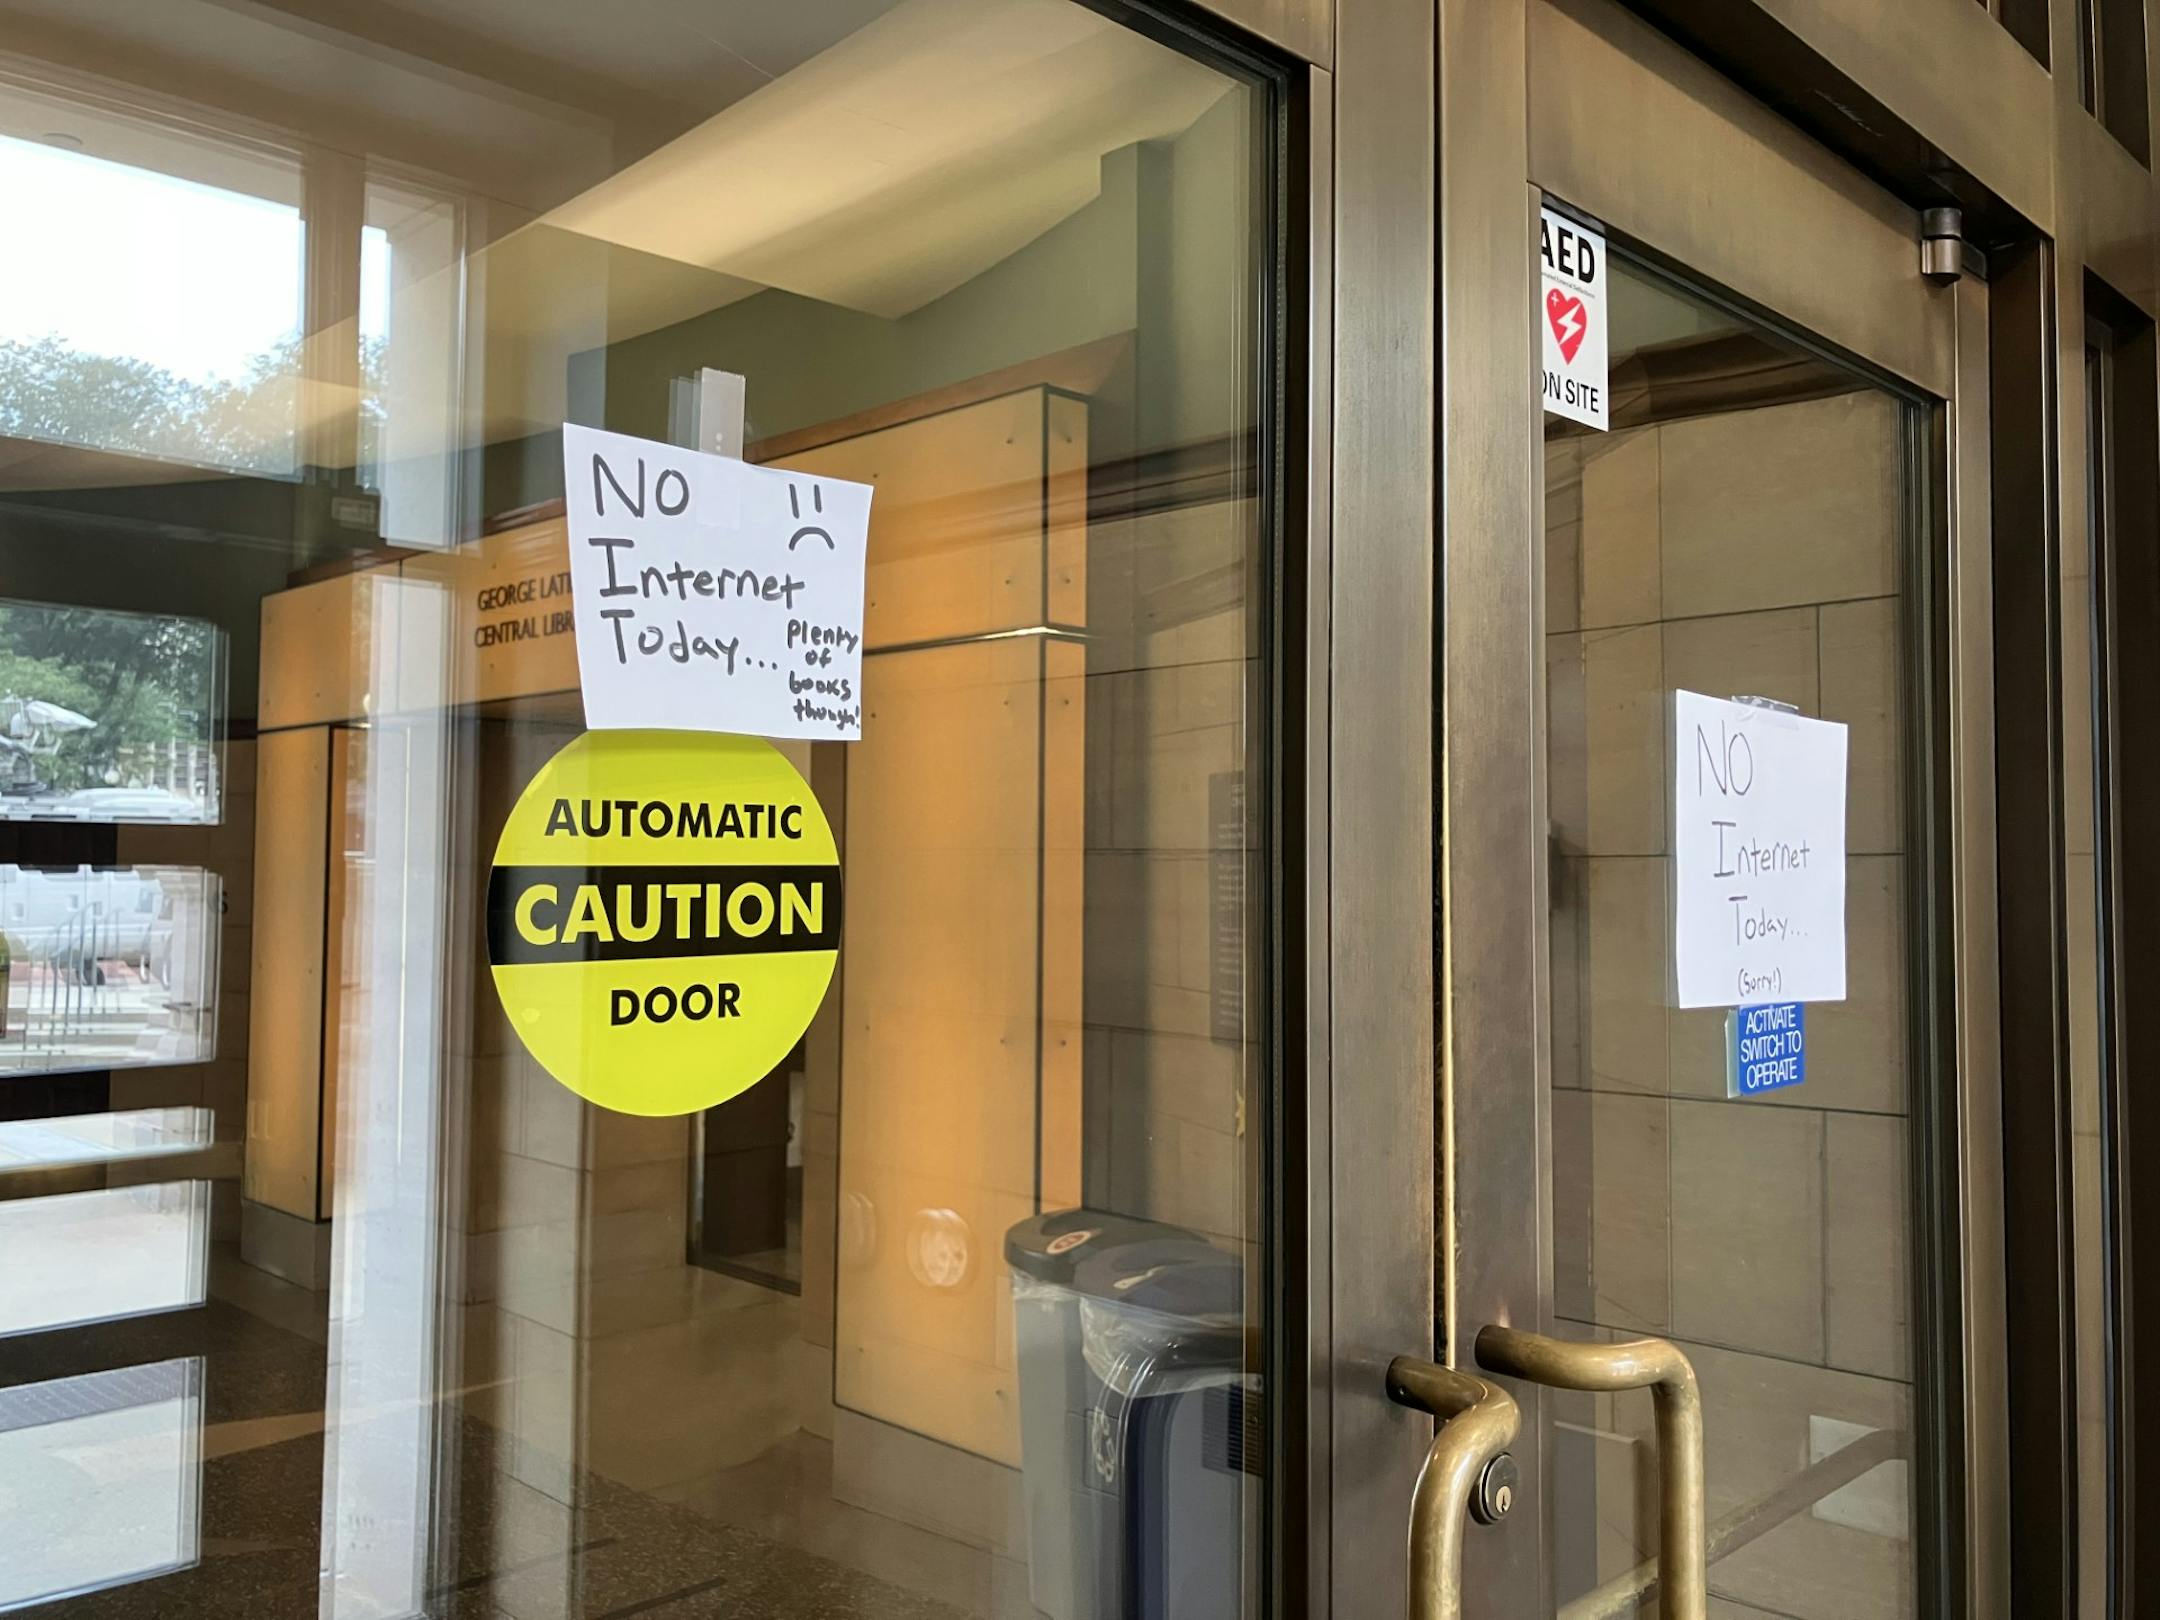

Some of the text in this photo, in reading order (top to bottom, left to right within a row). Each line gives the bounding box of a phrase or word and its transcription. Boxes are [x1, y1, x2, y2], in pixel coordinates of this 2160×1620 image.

[1541, 218, 1595, 283] AED
[1565, 378, 1599, 413] SITE
[588, 537, 805, 609] Internet
[477, 578, 537, 611] GEORGE
[474, 616, 538, 648] CENTRAL
[600, 608, 778, 676] Today...
[805, 647, 832, 669] of
[789, 670, 852, 702] books
[544, 798, 803, 840] AUTOMATIC
[1711, 820, 1811, 878] Internet
[514, 881, 824, 946] CAUTION
[1738, 967, 1782, 997] (Sorry!)
[610, 982, 741, 1027] DOOR
[1745, 1005, 1797, 1034] ACTIVATE
[1740, 1030, 1802, 1063] SWITCH TO
[1746, 1057, 1798, 1089] OPERATE
